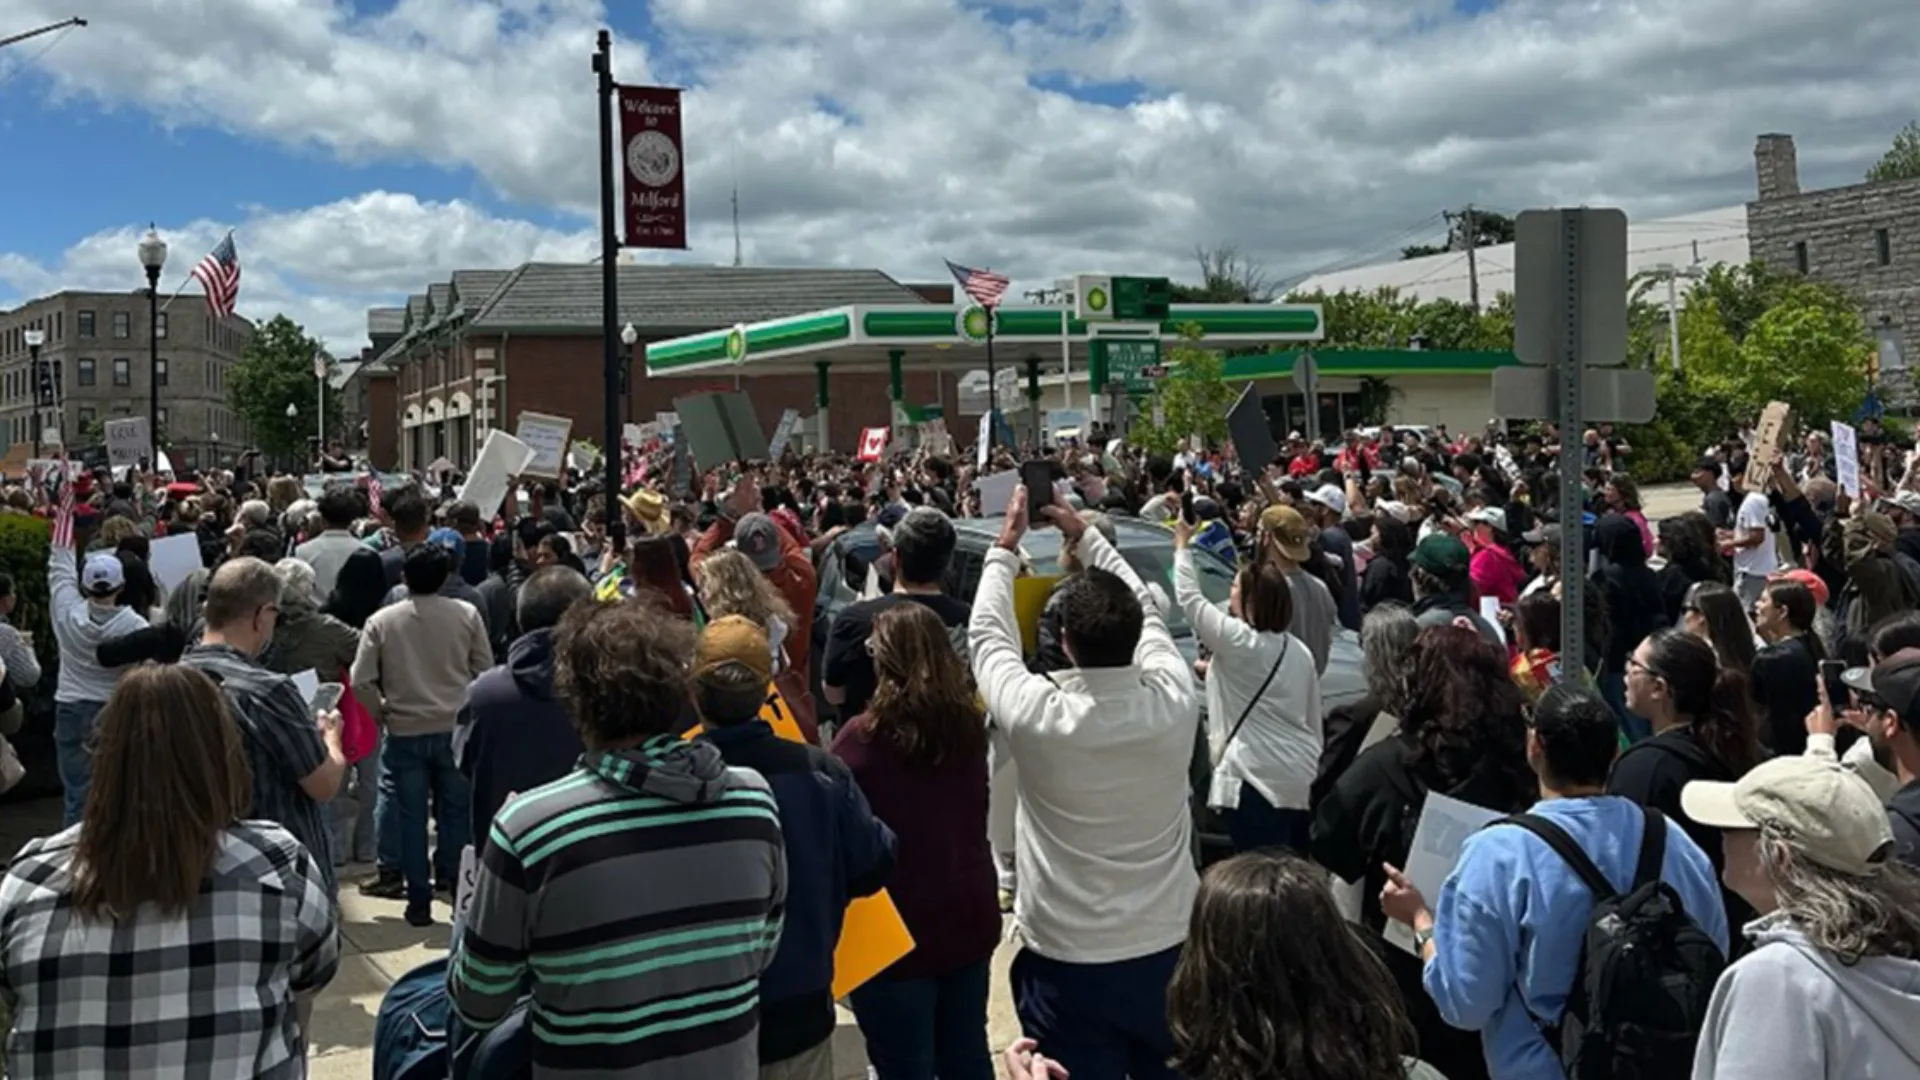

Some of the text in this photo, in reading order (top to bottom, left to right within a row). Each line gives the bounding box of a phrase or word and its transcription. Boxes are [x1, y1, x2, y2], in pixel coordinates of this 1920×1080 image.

[623, 99, 677, 115] Welcome
[644, 116, 659, 128] to
[632, 190, 680, 212] Milford
